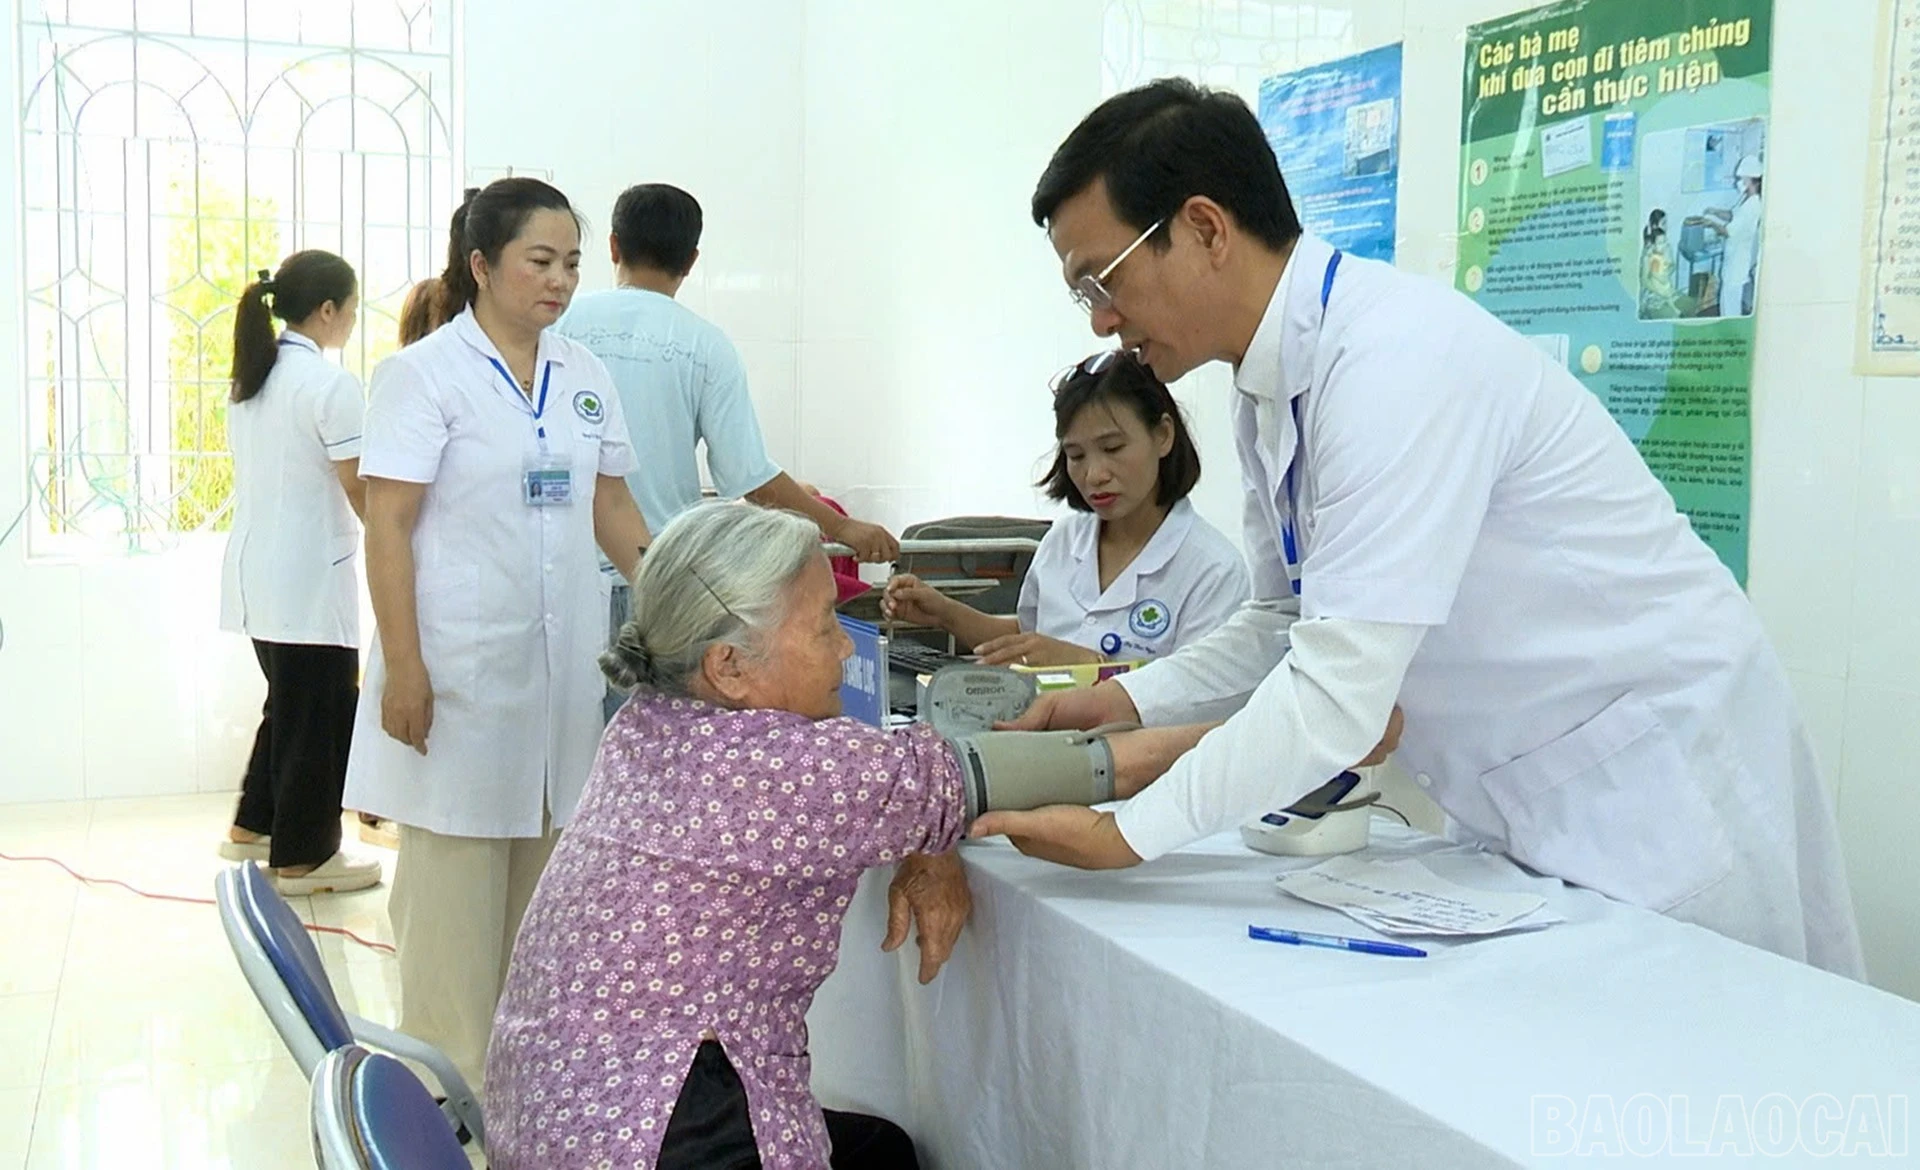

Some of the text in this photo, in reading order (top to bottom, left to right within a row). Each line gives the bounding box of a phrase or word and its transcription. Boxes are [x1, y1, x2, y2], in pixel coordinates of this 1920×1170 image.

[1479, 25, 1580, 69] Các bà mẹ
[1512, 65, 1545, 91] đưa
[1552, 55, 1588, 81] con
[1593, 46, 1614, 74] đi
[1620, 34, 1670, 67] tiêm
[1678, 17, 1751, 53] chủng
[1542, 60, 1720, 116] cần thực hiện
